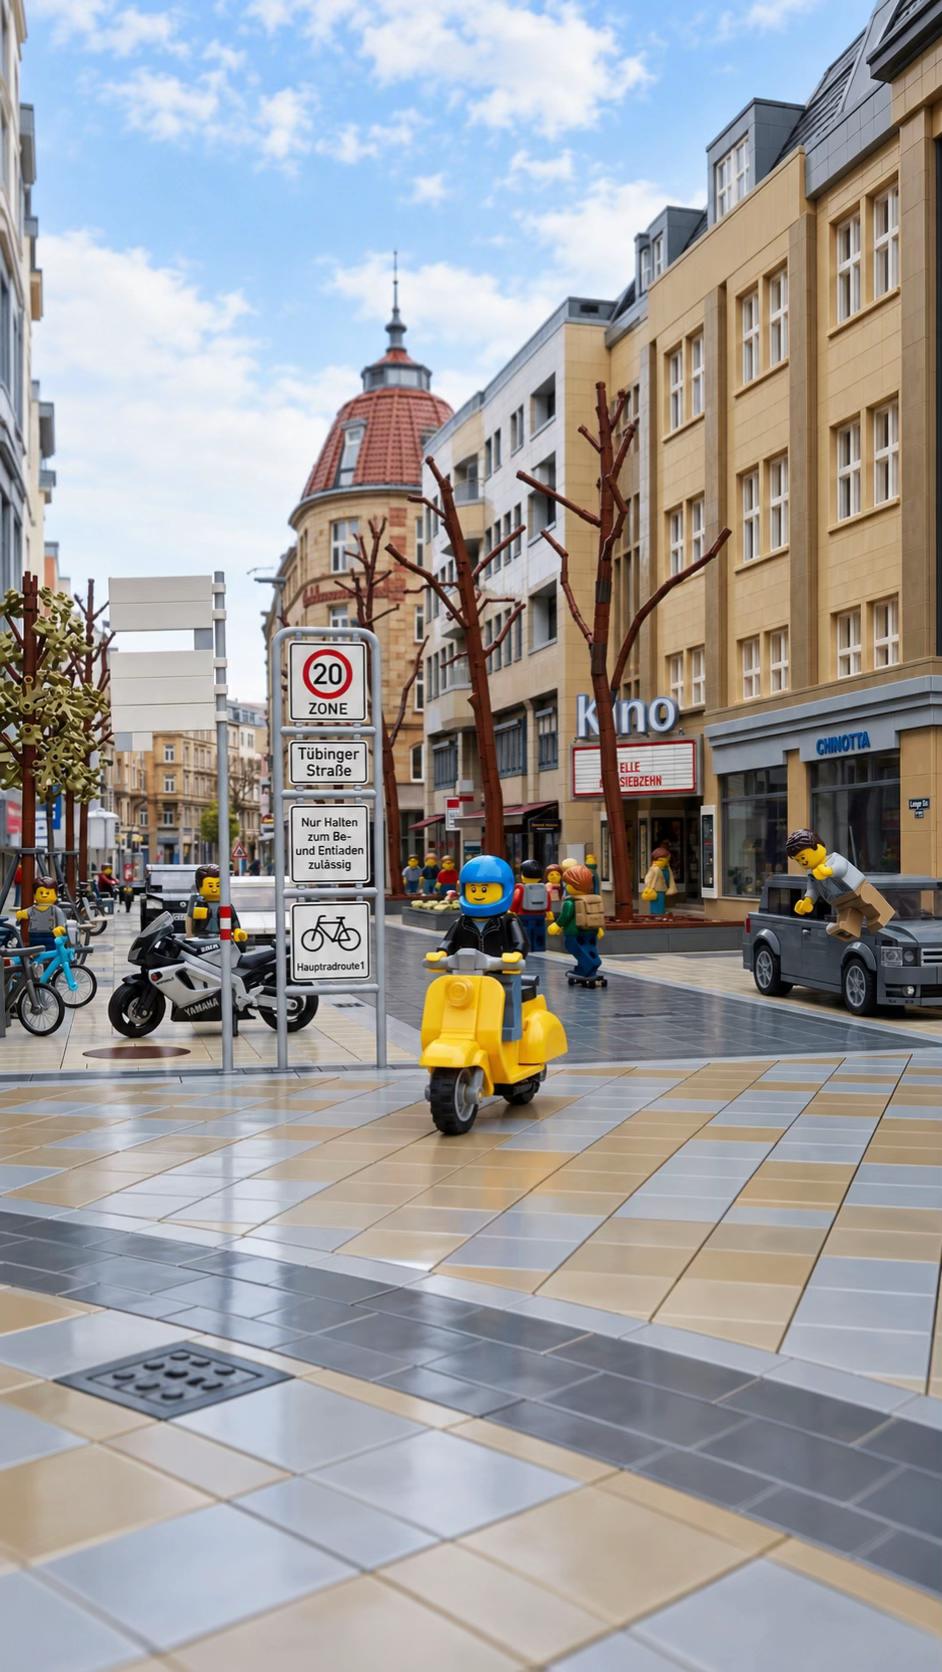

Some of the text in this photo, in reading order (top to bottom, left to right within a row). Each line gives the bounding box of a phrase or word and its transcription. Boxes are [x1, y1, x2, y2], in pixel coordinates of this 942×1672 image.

[313, 663, 342, 685] 20
[309, 702, 348, 715] ZONE
[816, 731, 871, 755] CHINOTTA
[298, 747, 360, 763] Tübinger
[307, 763, 352, 776] Straße
[619, 775, 662, 787] SIEBZEHN
[301, 817, 358, 828] Nur Halten
[307, 831, 352, 843] zum Be-
[295, 845, 316, 857] und
[308, 859, 352, 872] zulässig
[184, 997, 220, 1017] YAMAHA
